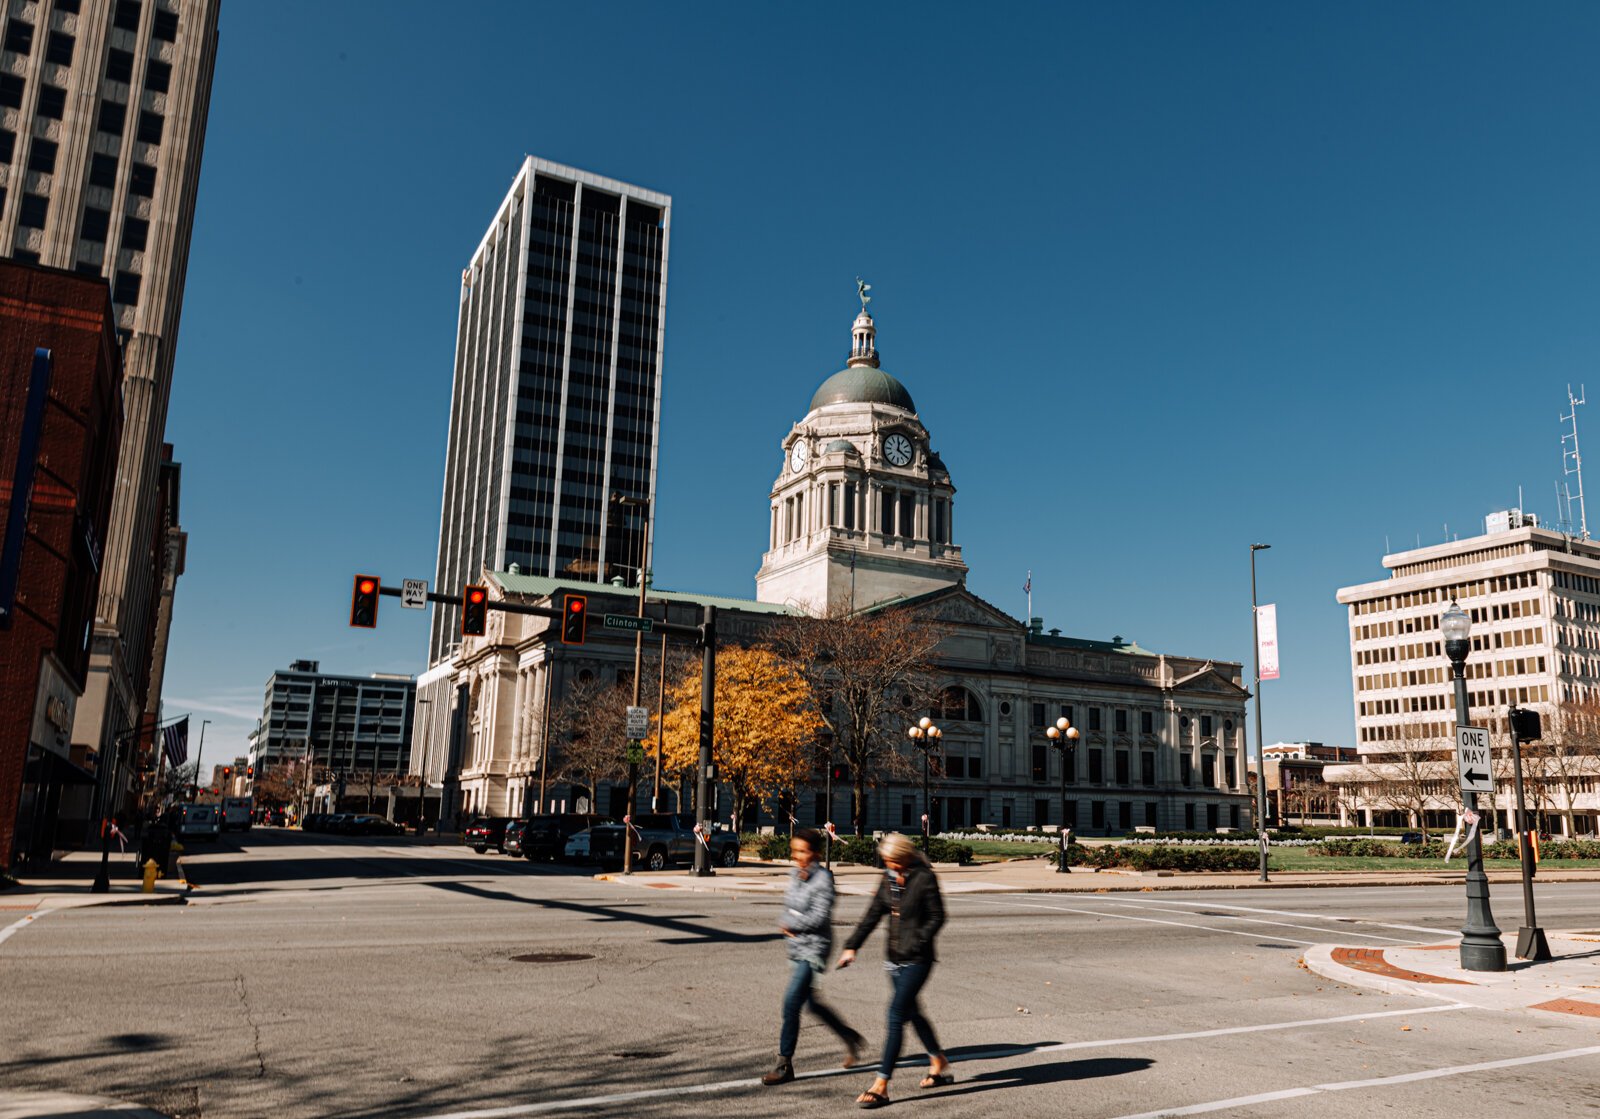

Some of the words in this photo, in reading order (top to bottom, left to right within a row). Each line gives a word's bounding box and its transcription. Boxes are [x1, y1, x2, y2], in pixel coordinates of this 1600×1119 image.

[407, 581, 424, 590] ONE
[406, 589, 424, 598] WAY
[606, 617, 638, 628] Clinton
[1462, 732, 1485, 747] ONE
[1462, 748, 1486, 764] WAY
